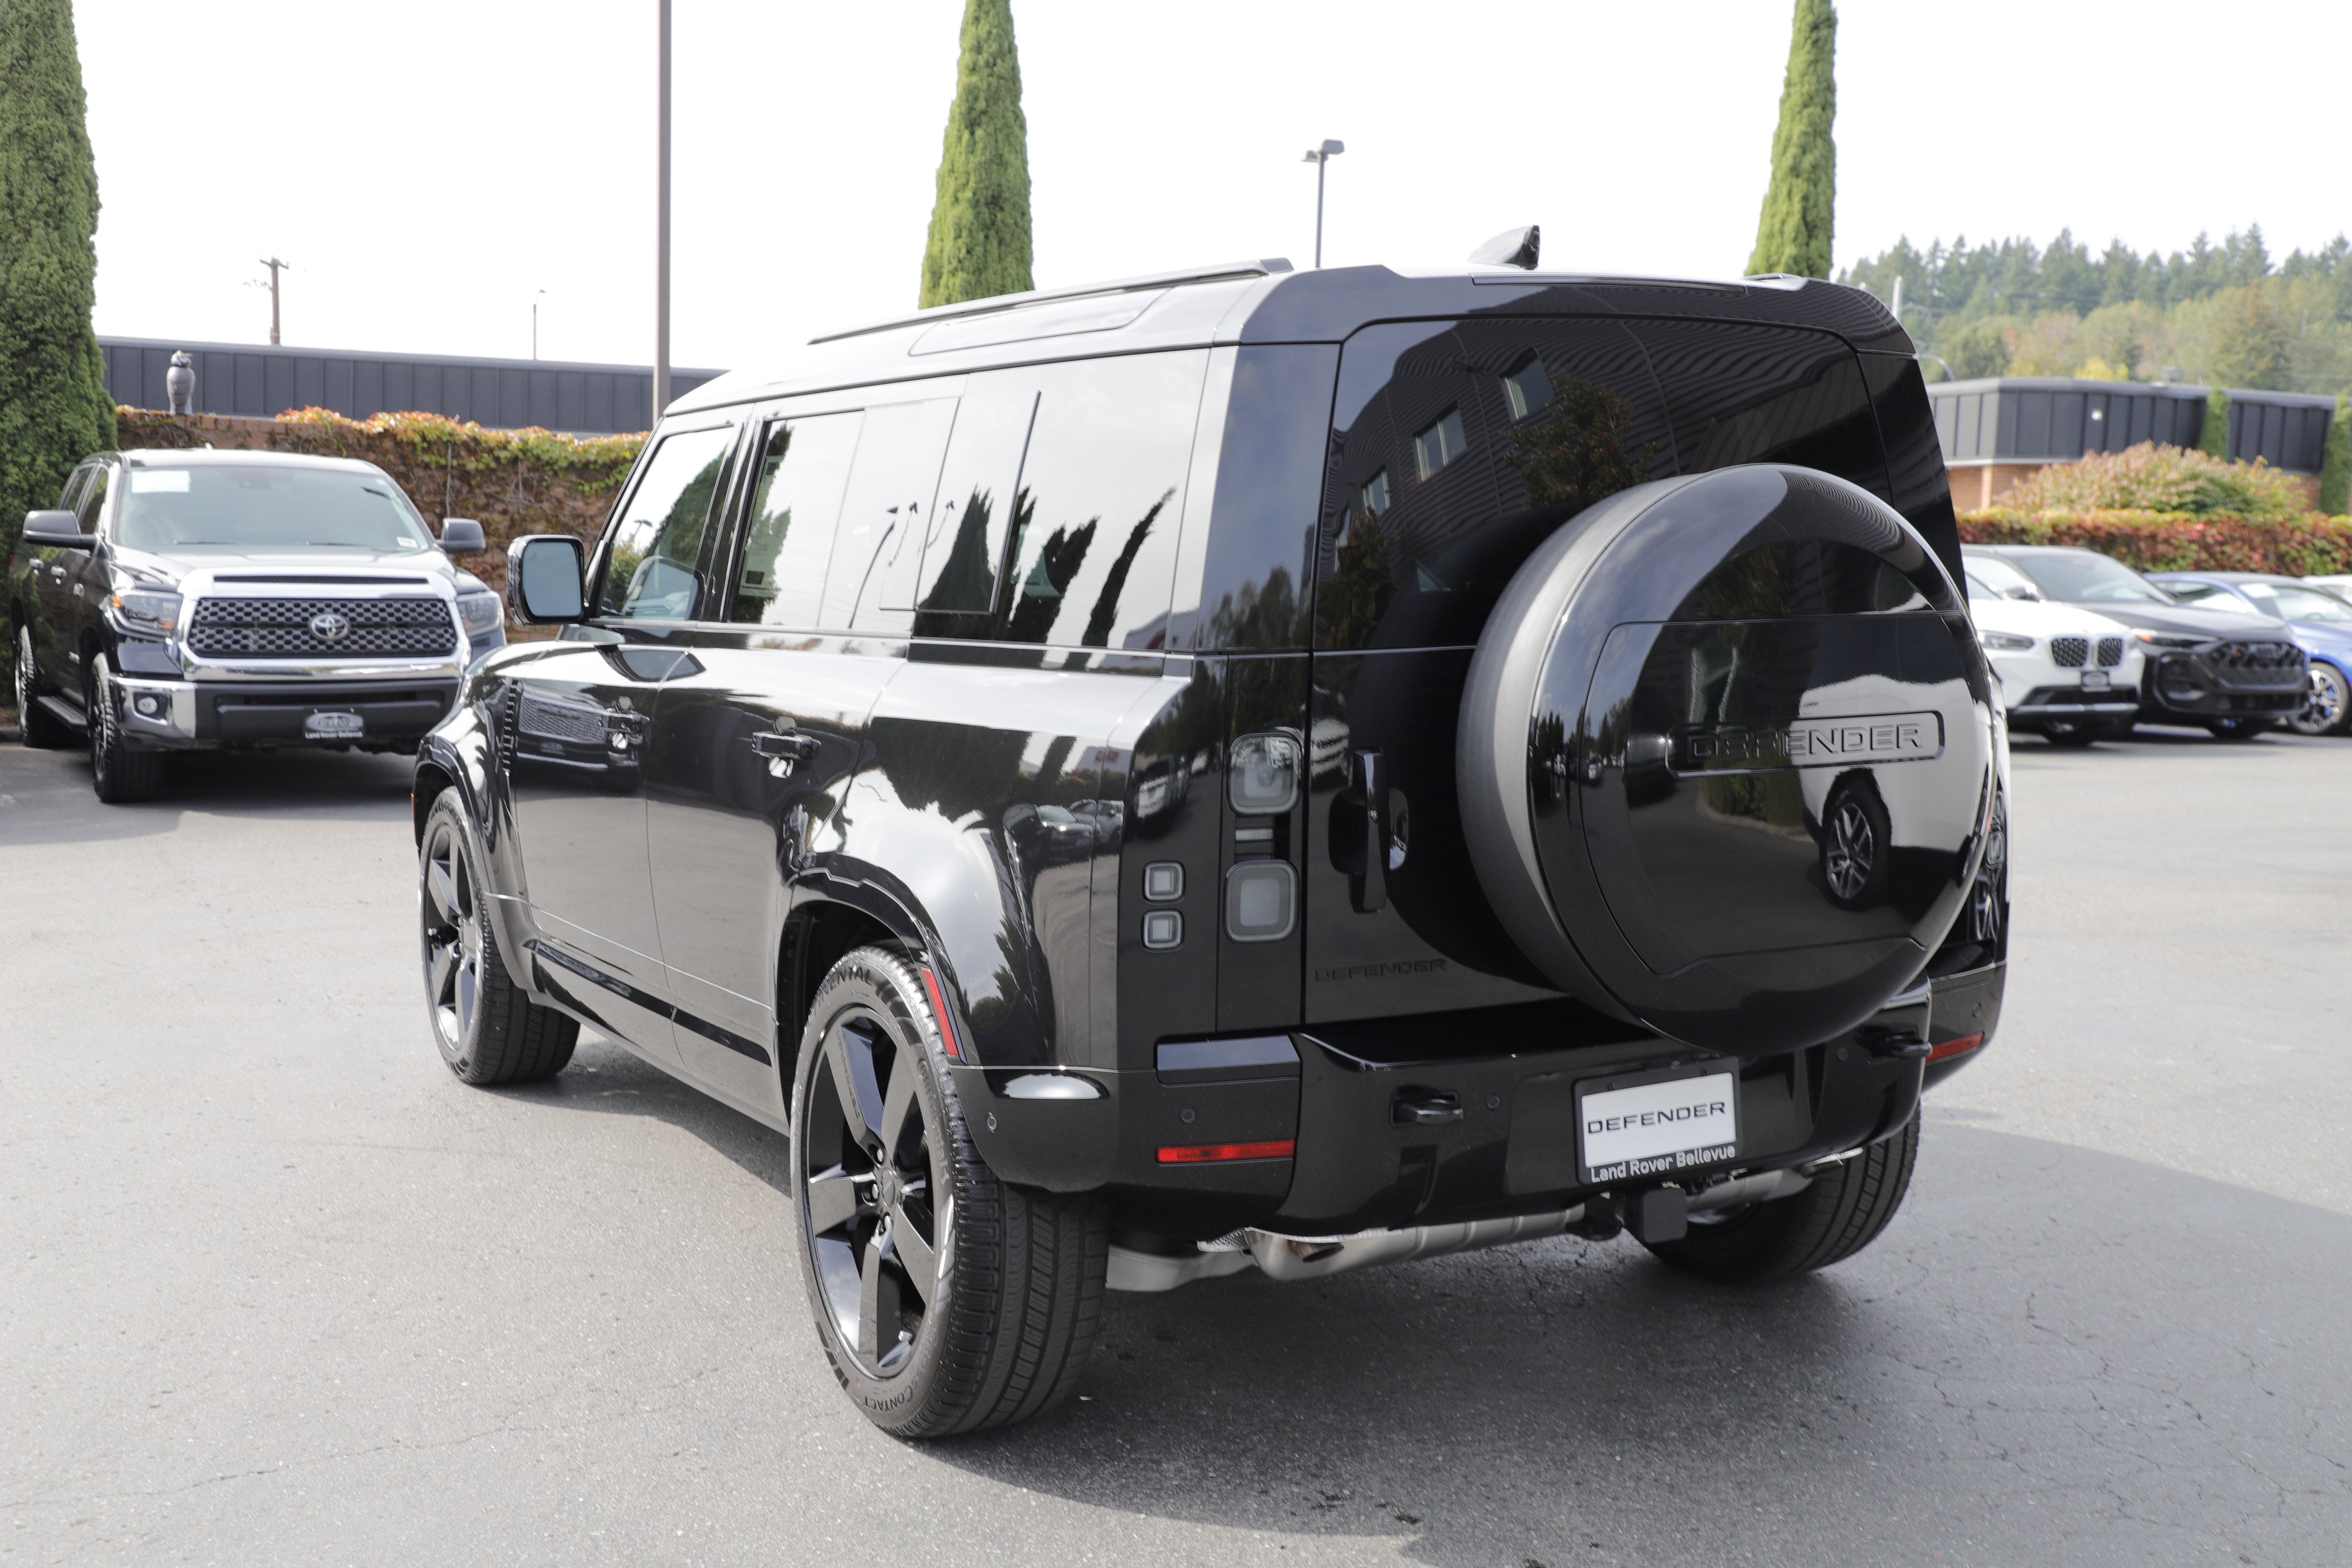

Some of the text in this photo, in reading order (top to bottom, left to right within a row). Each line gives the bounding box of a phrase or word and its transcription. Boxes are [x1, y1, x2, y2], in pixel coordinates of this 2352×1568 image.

[1687, 722, 1923, 762] DEFENDER
[1315, 958, 1447, 982] DEFENDER
[1587, 1100, 1726, 1136] DEFENDER
[1591, 1145, 1736, 1183] Land Rover Bellevue
